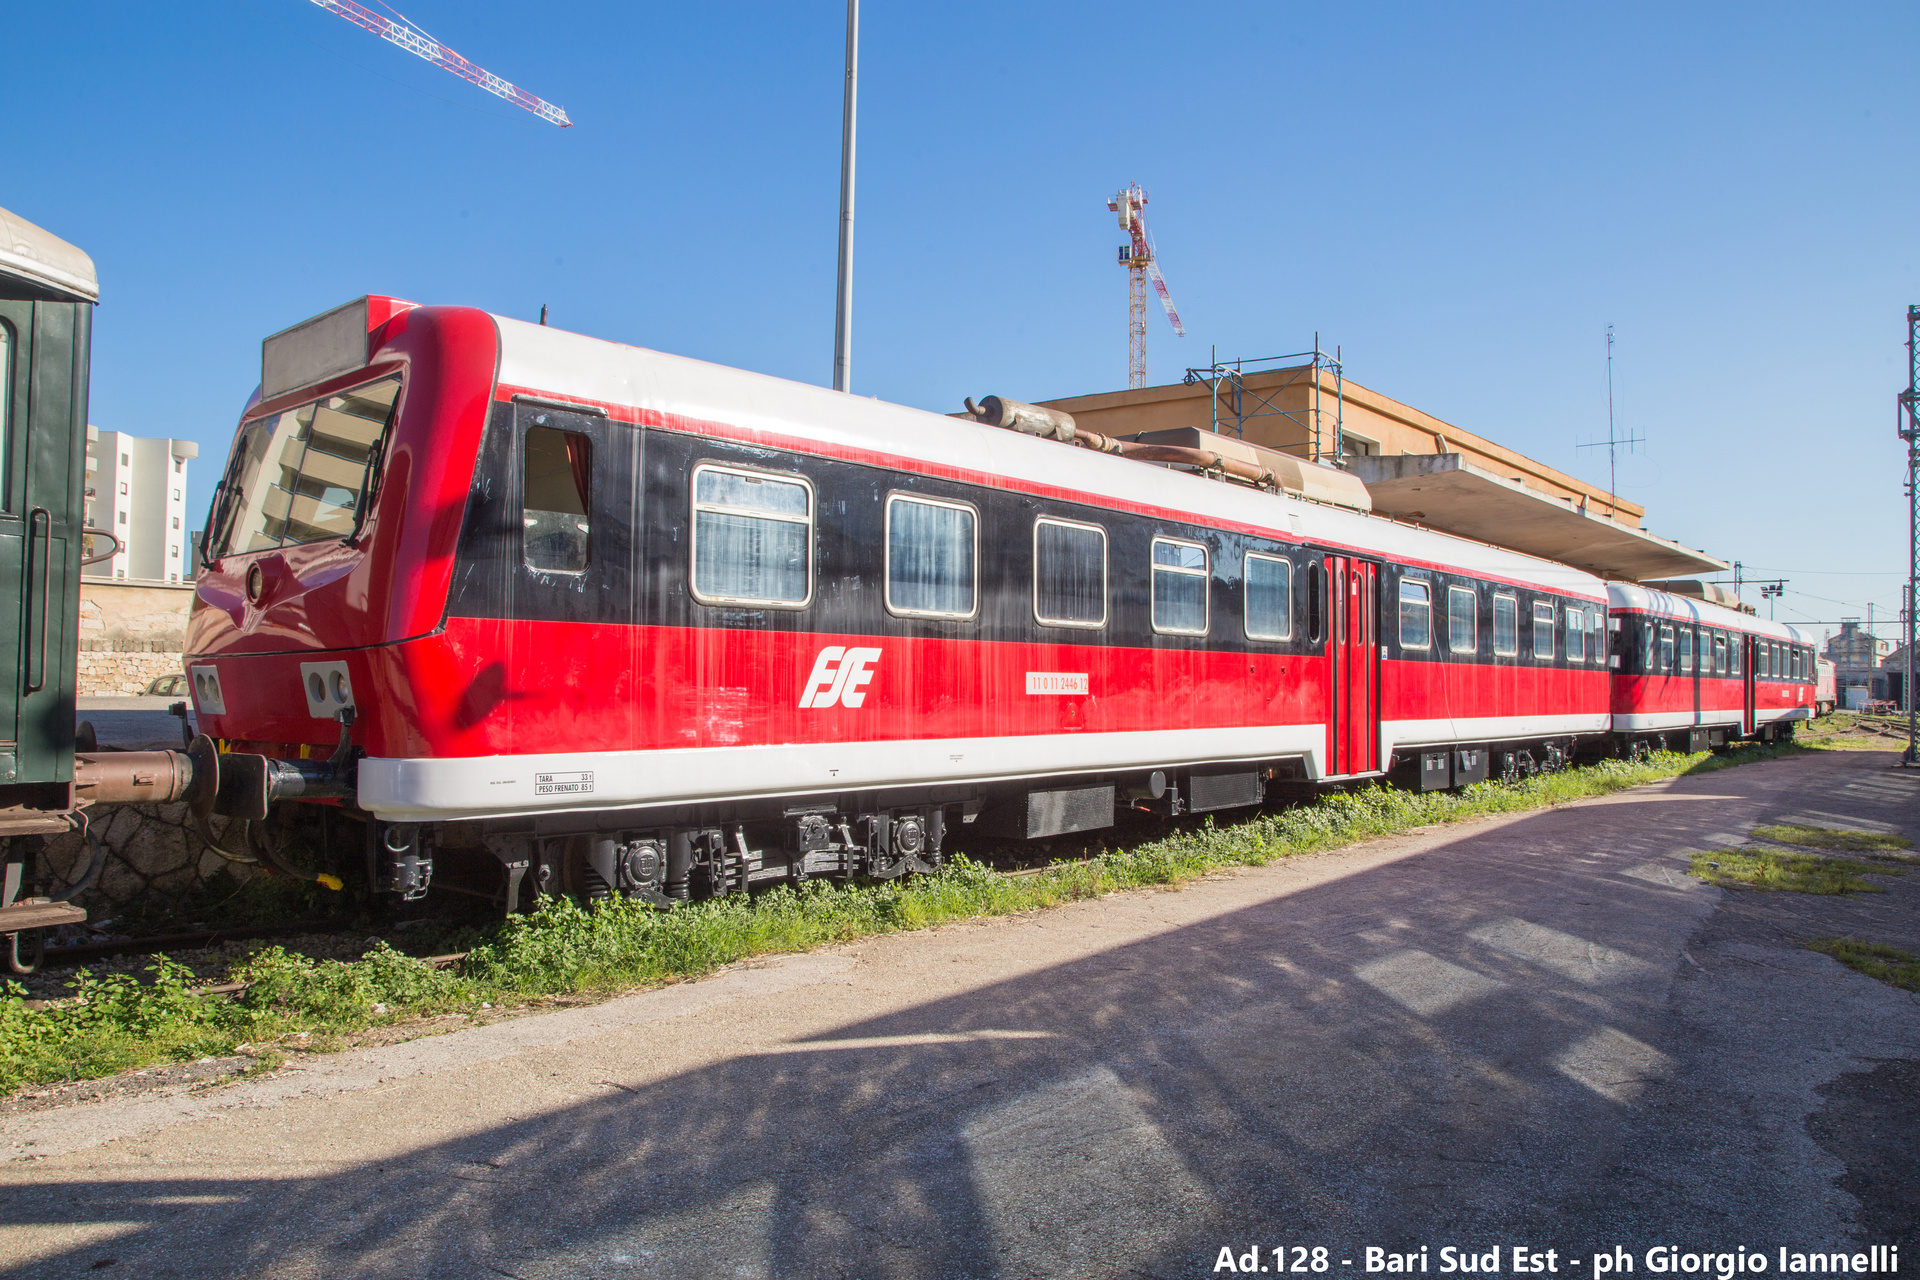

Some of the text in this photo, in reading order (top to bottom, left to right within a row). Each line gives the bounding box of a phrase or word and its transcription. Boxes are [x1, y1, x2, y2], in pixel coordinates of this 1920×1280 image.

[798, 646, 883, 708] FSE
[1033, 677, 1041, 690] 11
[1050, 677, 1058, 690] 11
[1060, 677, 1078, 690] 2446
[1080, 677, 1088, 691] 12
[539, 775, 553, 783] TARA
[581, 773, 588, 781] 33
[539, 785, 553, 793] PESO
[554, 784, 579, 792] FRENATO
[581, 783, 588, 791] 85
